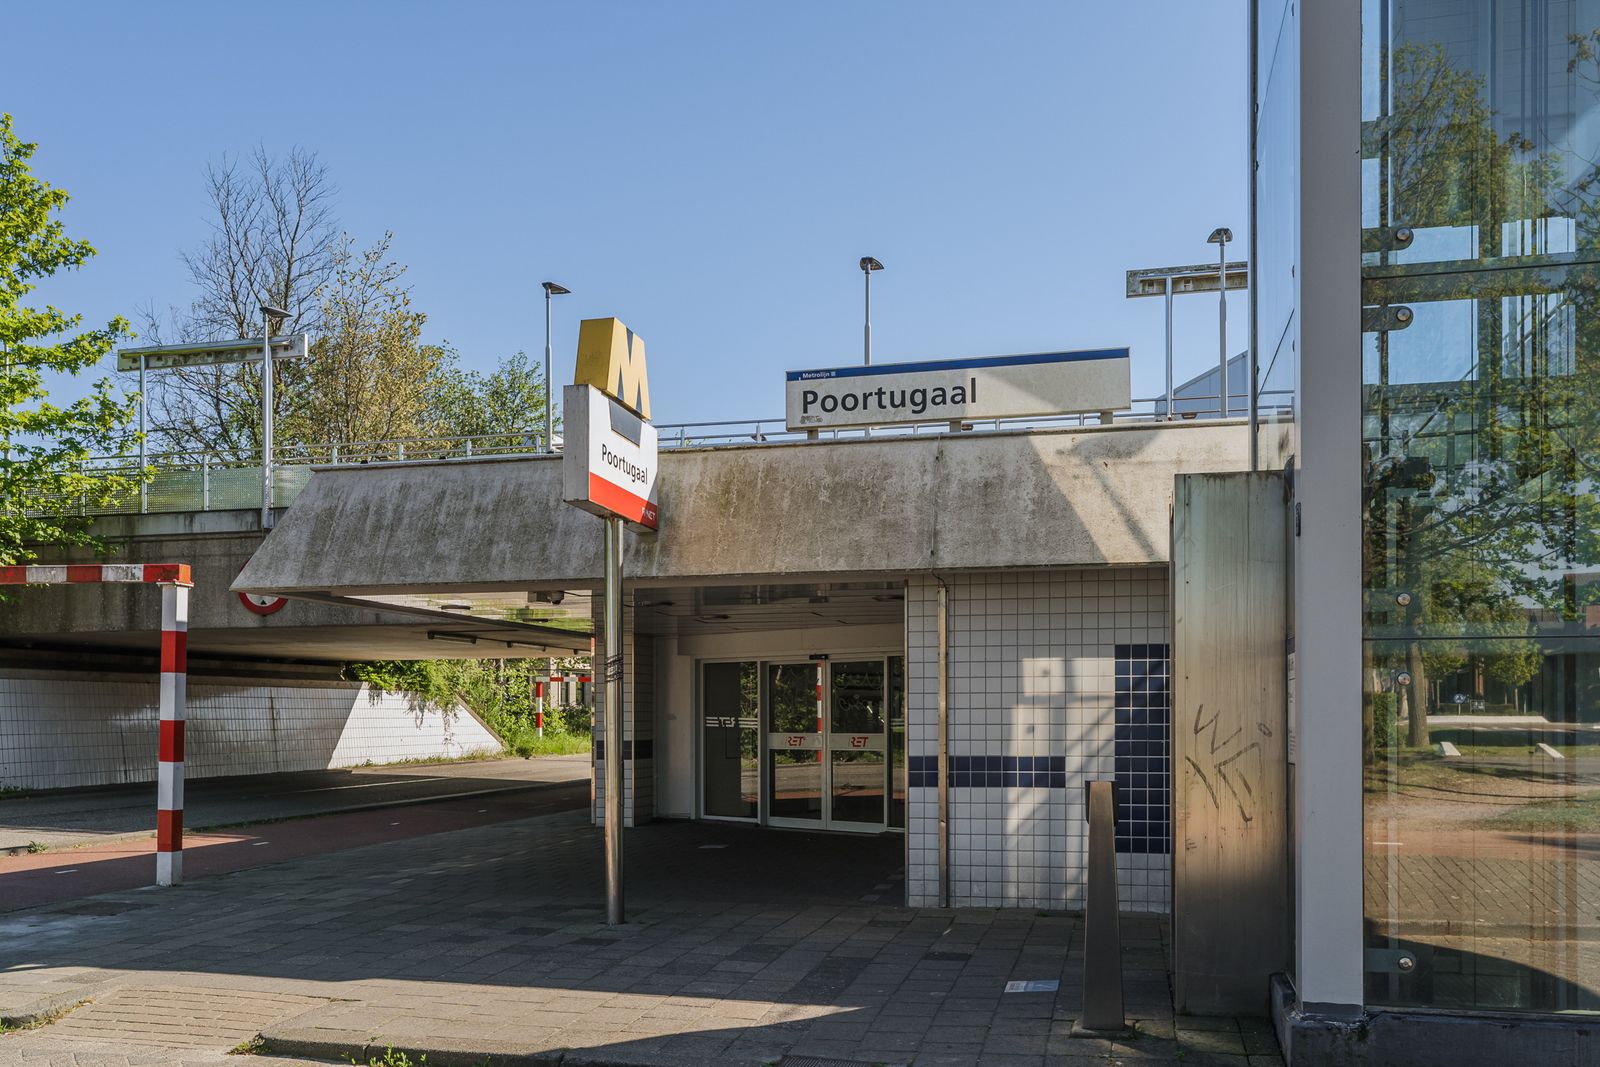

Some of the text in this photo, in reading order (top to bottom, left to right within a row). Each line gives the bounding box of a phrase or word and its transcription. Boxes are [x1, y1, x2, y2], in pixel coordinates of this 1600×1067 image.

[605, 317, 651, 420] M
[802, 371, 830, 379] Metrolijn
[802, 377, 976, 414] Poortugaal
[601, 443, 648, 485] Poortugaal
[787, 735, 806, 747] RET
[850, 736, 869, 748] RET
